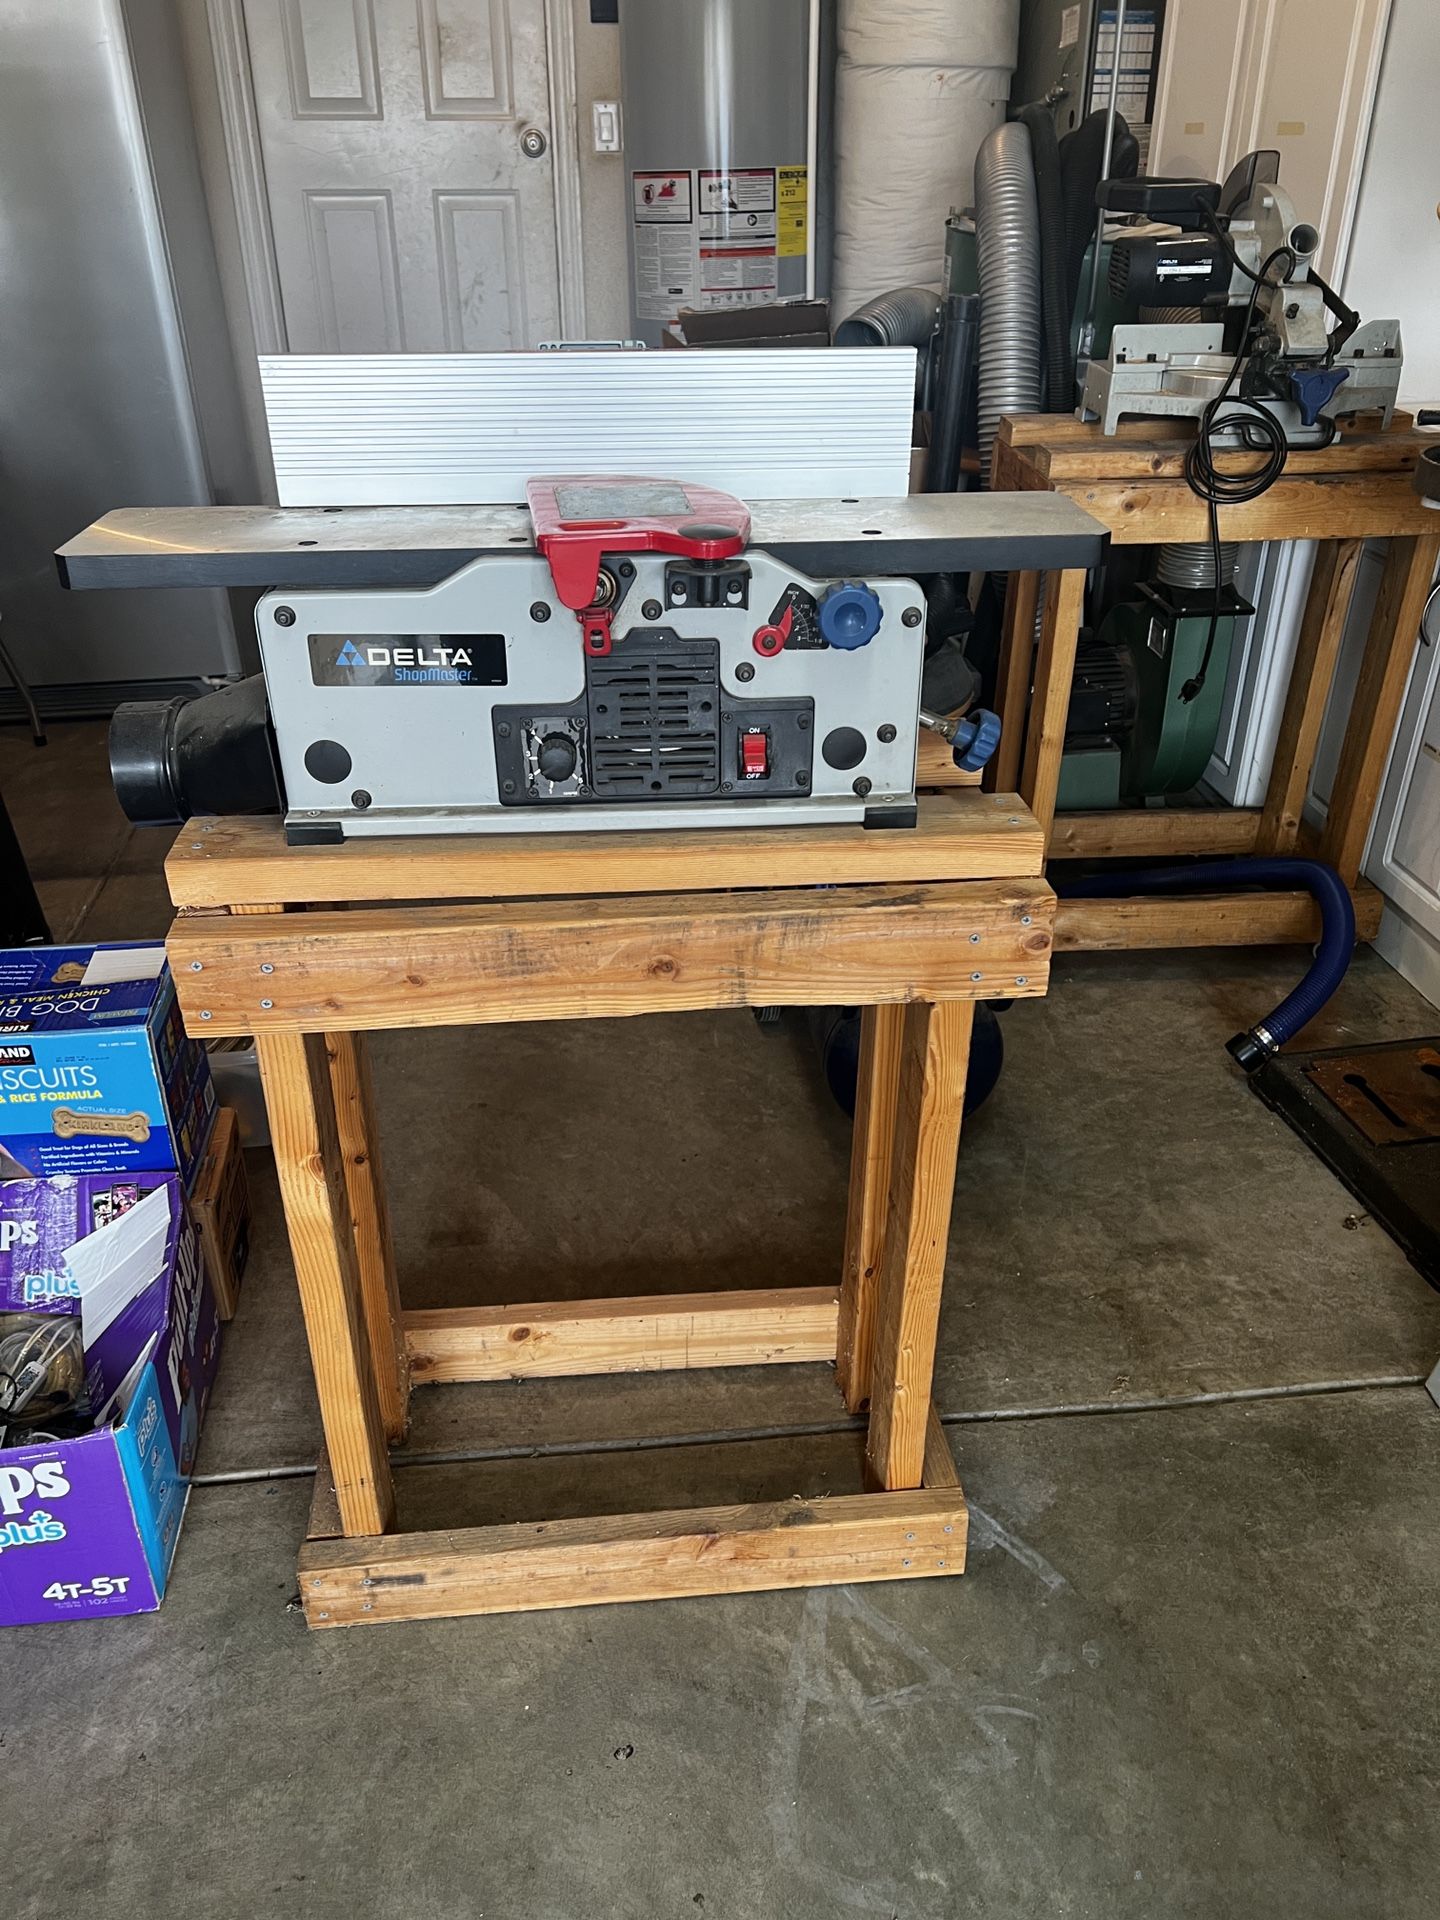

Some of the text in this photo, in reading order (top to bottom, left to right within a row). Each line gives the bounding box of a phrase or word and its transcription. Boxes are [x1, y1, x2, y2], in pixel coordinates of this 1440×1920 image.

[367, 648, 473, 666] DELTA
[394, 668, 472, 683] ShopMaster
[22, 994, 55, 1003] MEAL
[58, 988, 110, 999] CHICKEN
[31, 997, 100, 1016] DOG
[0, 1024, 30, 1032] KIR
[9, 1092, 37, 1103] RICE
[40, 1089, 103, 1101] FORMULA
[0, 1220, 39, 1251] ps
[0, 1461, 71, 1515] ps
[42, 1577, 130, 1600] 4T-5T
[88, 1598, 109, 1606] 102
